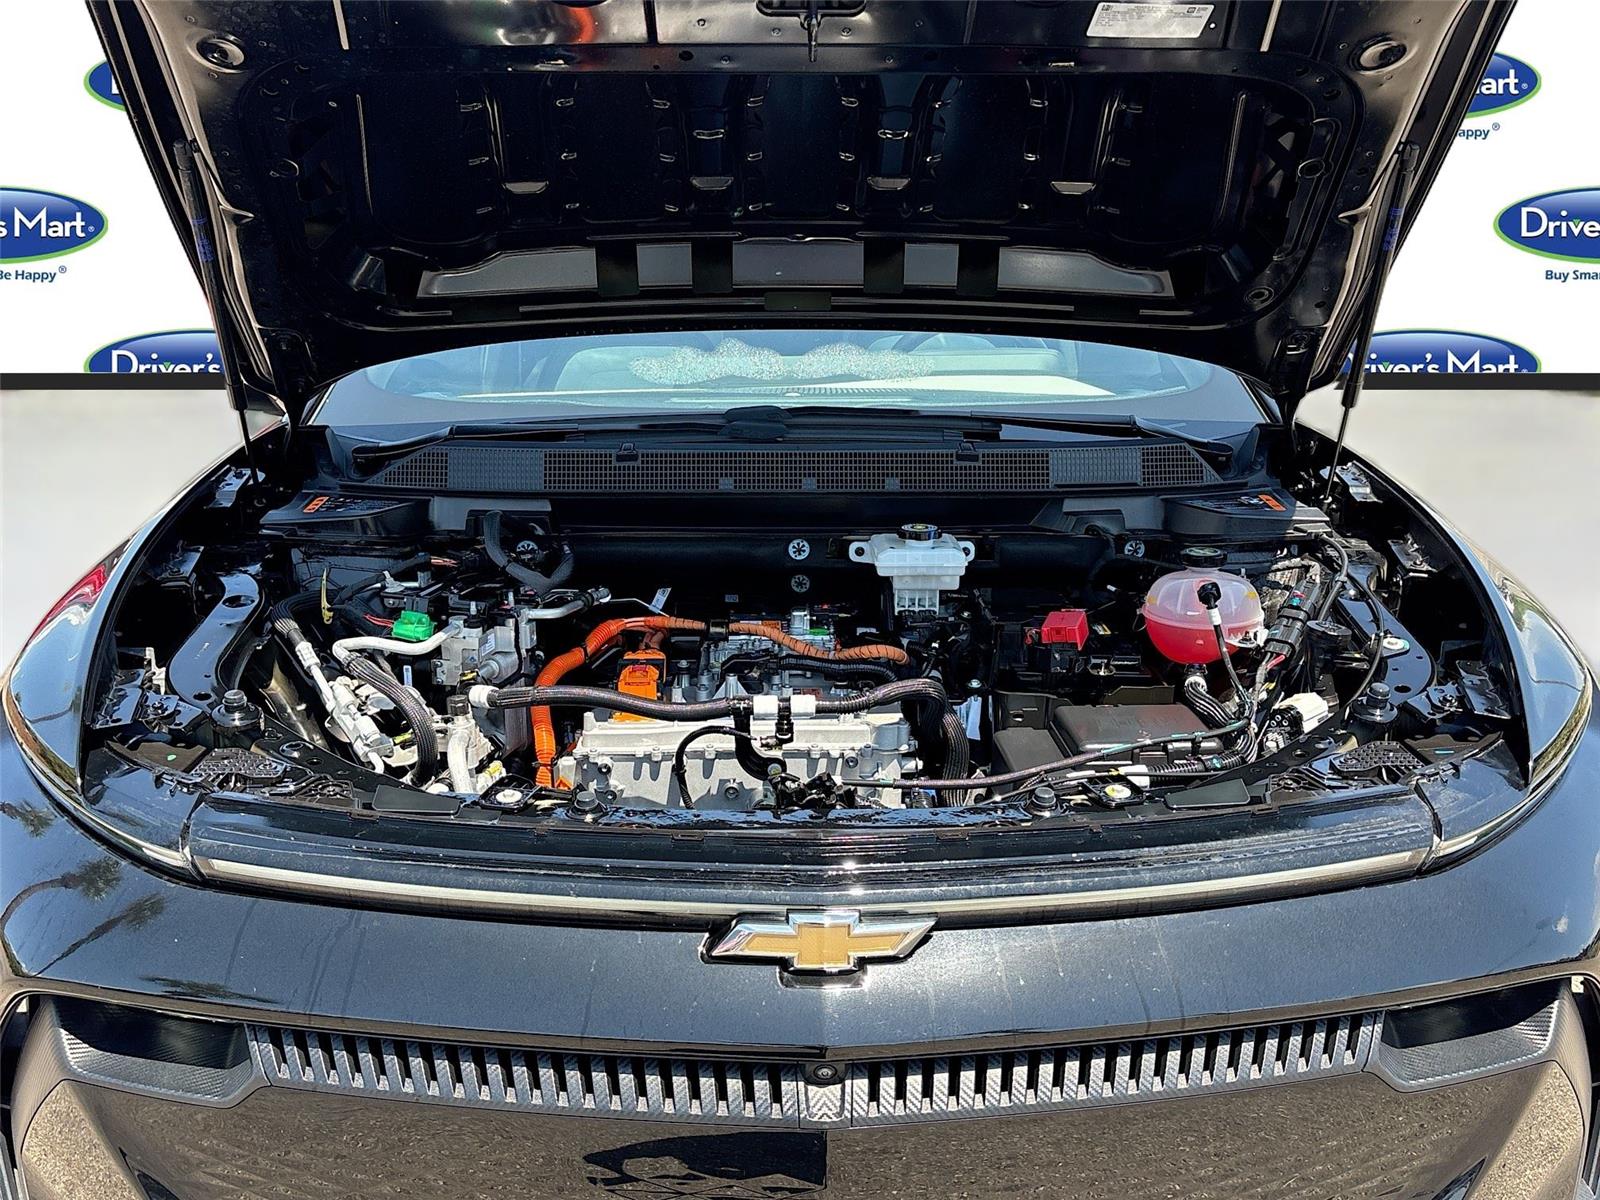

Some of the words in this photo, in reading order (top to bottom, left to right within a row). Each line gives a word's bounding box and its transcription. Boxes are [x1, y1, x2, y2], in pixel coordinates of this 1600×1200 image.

[1476, 69, 1519, 94] art
[1456, 129, 1490, 140] appy
[14, 207, 86, 237] Mart
[15, 270, 56, 283] Happy
[1545, 270, 1569, 283] Buy
[1572, 270, 1600, 280] Sma
